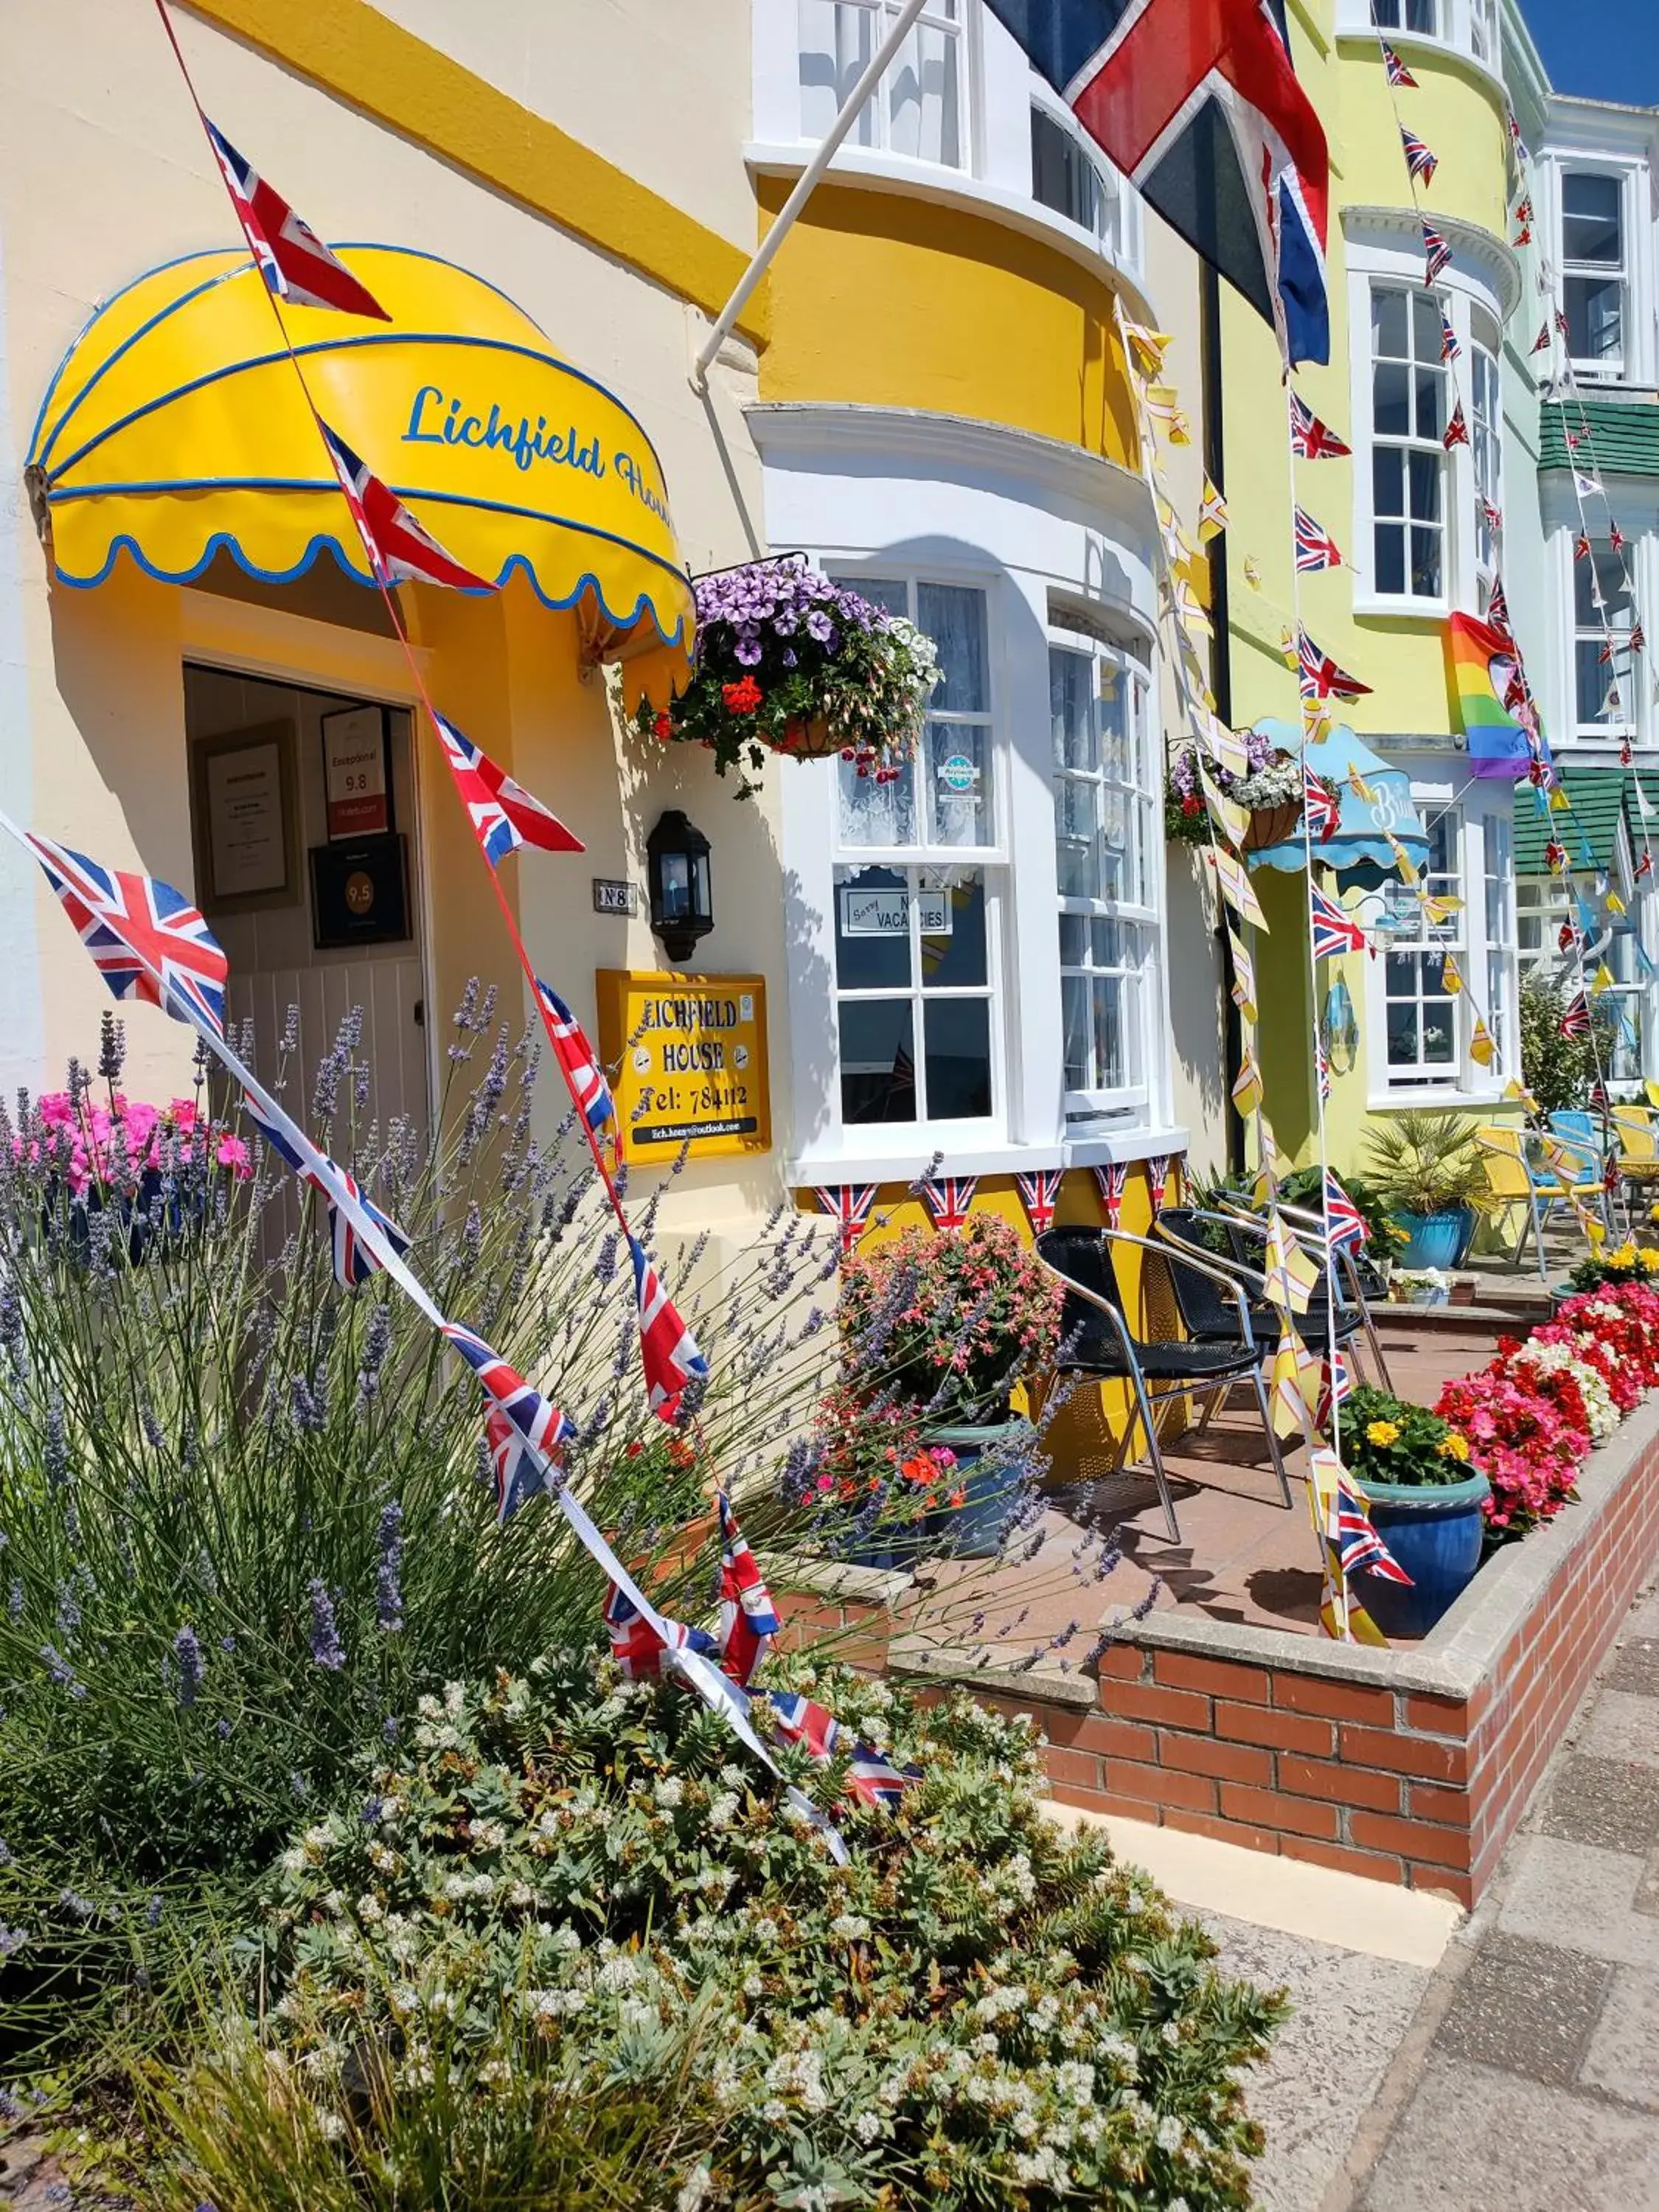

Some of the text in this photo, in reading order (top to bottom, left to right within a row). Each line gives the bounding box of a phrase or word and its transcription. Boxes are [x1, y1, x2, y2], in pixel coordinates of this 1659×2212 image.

[402, 386, 605, 478] Lichfield
[345, 773, 367, 792] 9.8
[348, 884, 370, 902] 9.5
[877, 912, 942, 928] VACACIES
[663, 1042, 724, 1072] HOUSE
[690, 1086, 749, 1115] 784112
